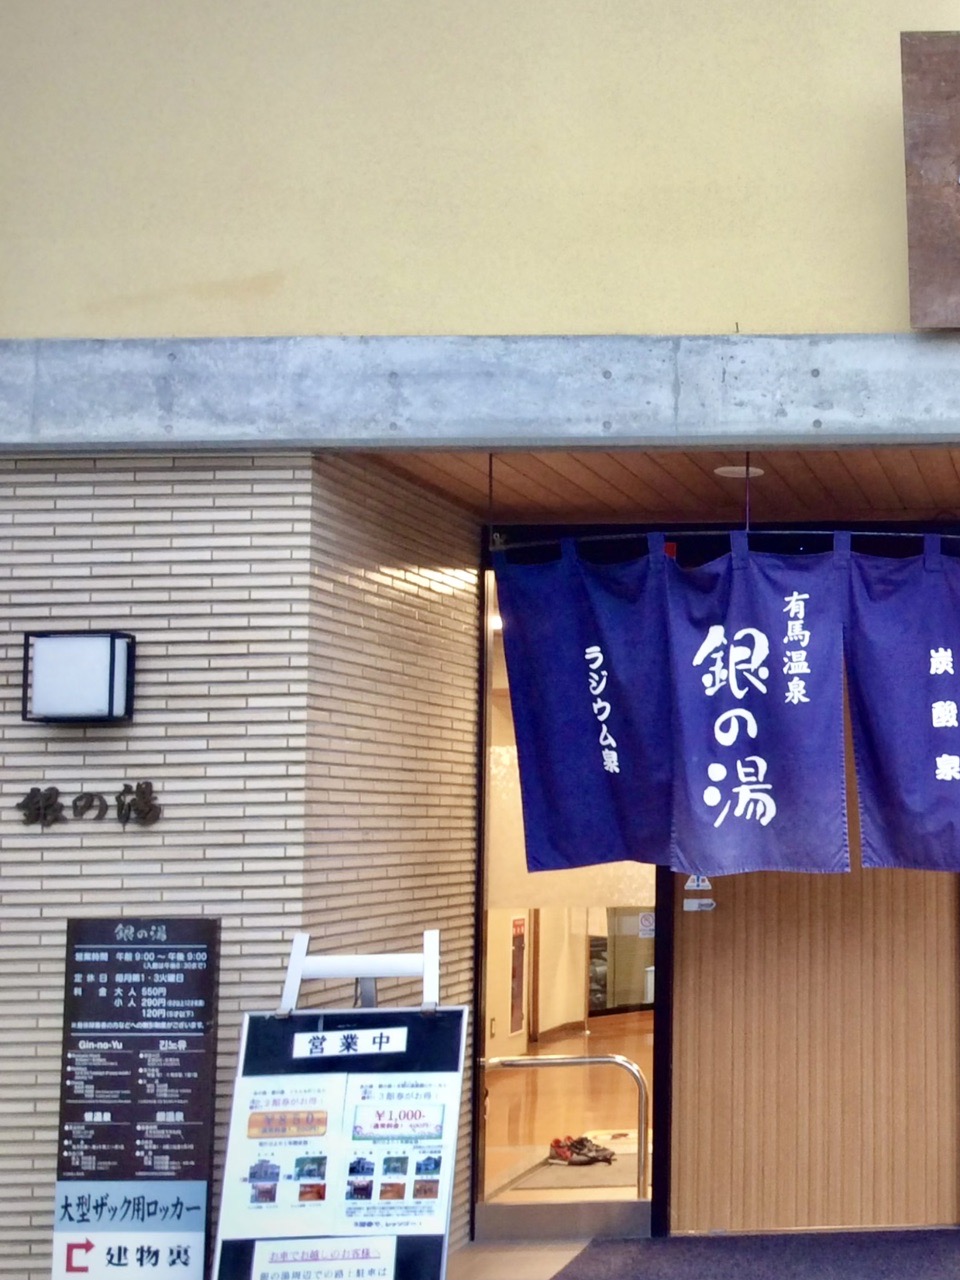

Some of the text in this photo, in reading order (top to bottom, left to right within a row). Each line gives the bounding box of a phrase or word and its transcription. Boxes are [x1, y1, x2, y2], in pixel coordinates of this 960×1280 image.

[782, 591, 812, 704] 有馬温泉
[584, 645, 621, 774] ラジウム泉
[692, 624, 777, 828] 銀の湯
[16, 781, 162, 826] 銀の湯
[114, 923, 167, 941] 銀の湯
[308, 1032, 390, 1056] 営業中
[60, 1193, 201, 1224] 大型ザック用ロッカー
[106, 1245, 191, 1268] 建物裏
